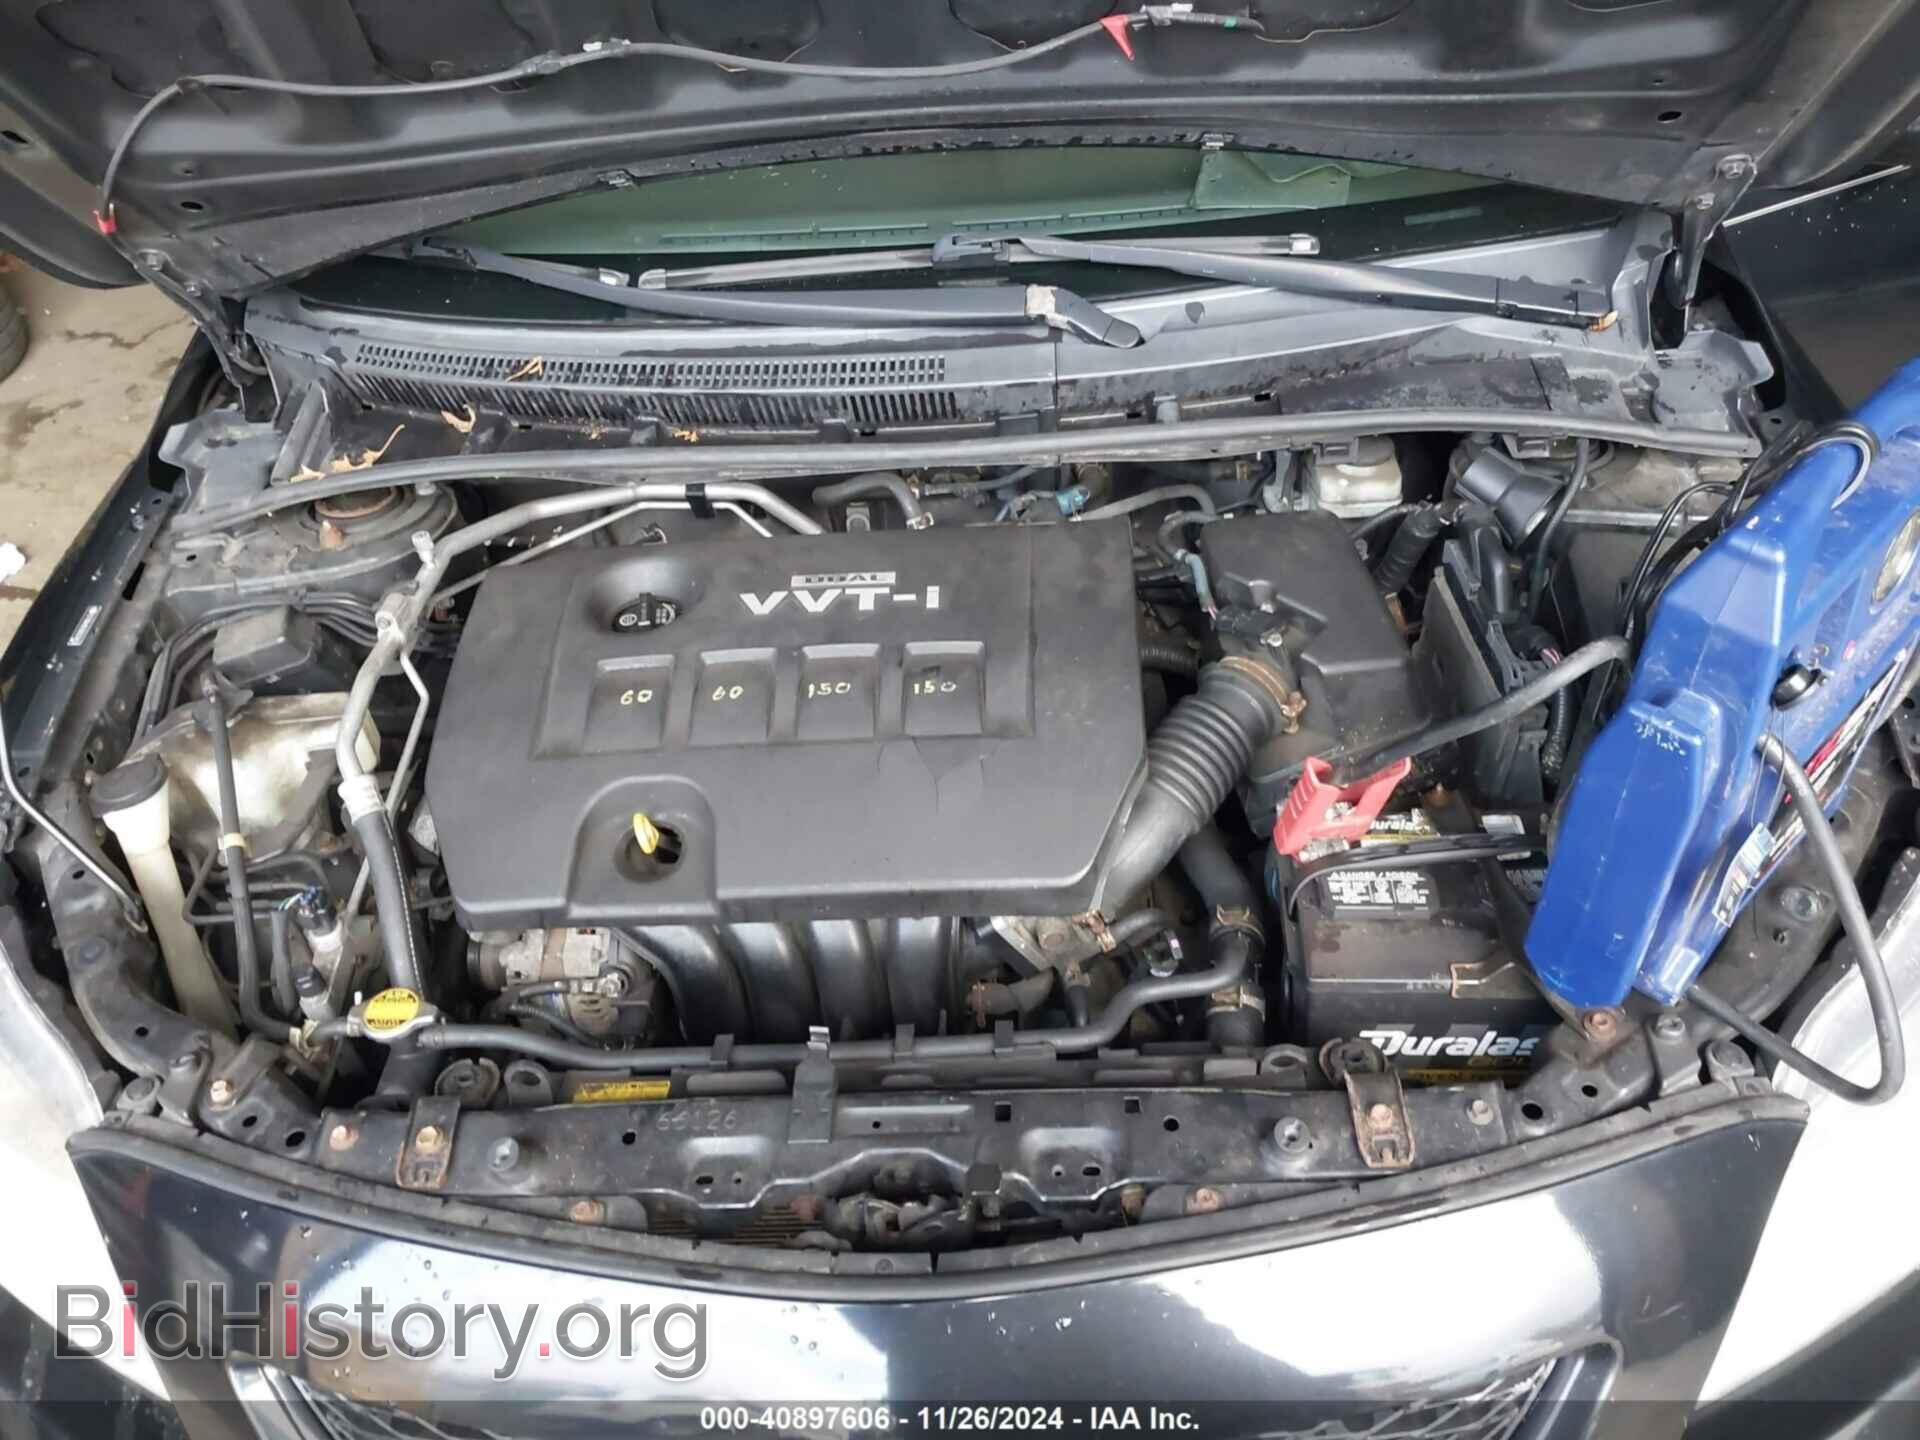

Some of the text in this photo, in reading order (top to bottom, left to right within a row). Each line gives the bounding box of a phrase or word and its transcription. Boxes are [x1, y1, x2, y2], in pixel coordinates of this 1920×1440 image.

[711, 685, 745, 701] 60
[807, 682, 852, 699] 150
[912, 679, 957, 696] 150
[619, 689, 653, 706] 60
[1359, 1029, 1541, 1057] Duralas
